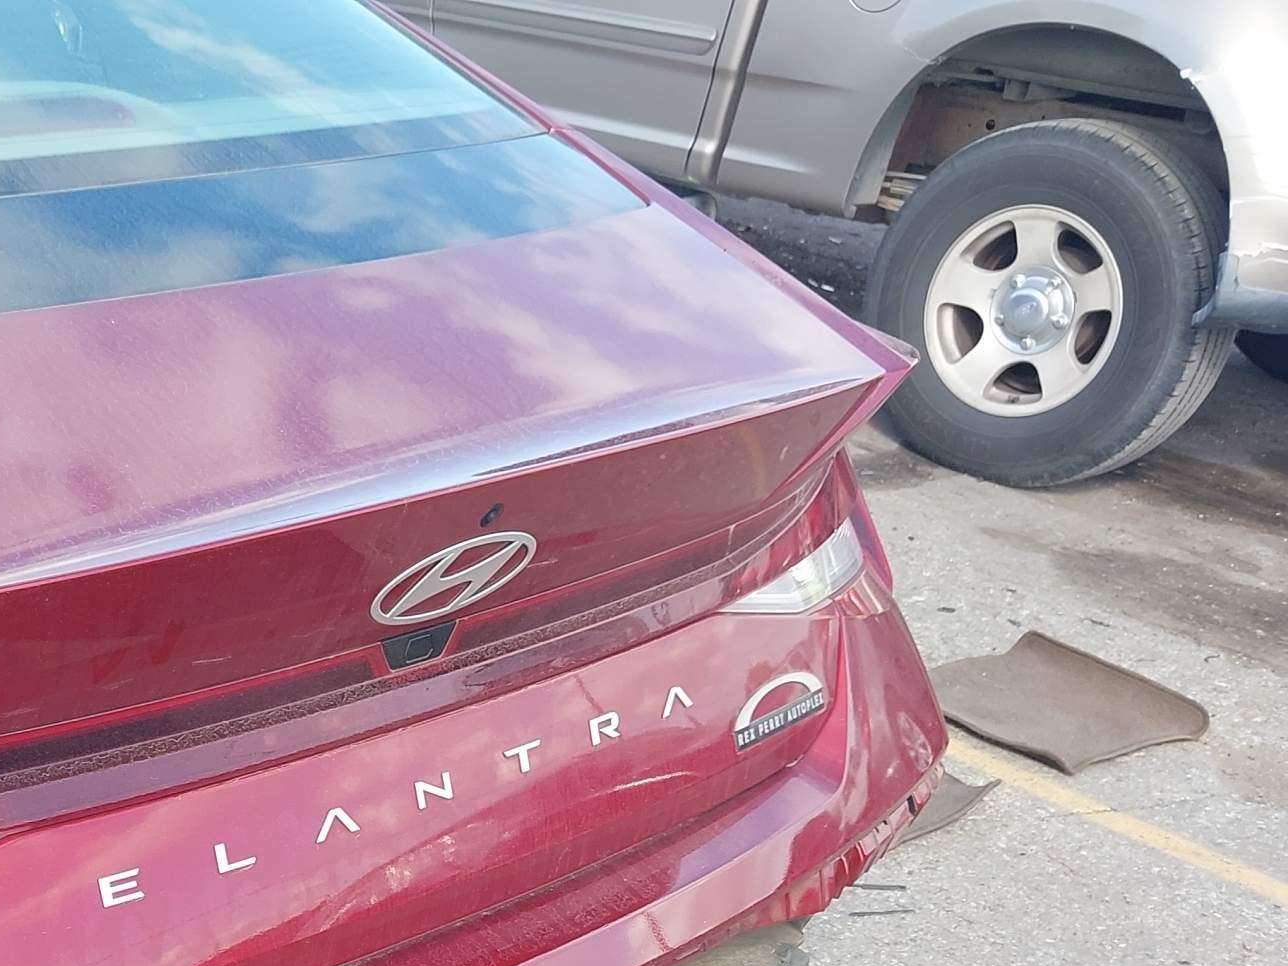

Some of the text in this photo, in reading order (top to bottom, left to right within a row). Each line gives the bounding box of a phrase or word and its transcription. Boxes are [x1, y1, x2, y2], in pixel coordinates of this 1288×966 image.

[737, 692, 824, 747] REX PERRY AUTOPLEX
[98, 685, 695, 909] ELANTRA
